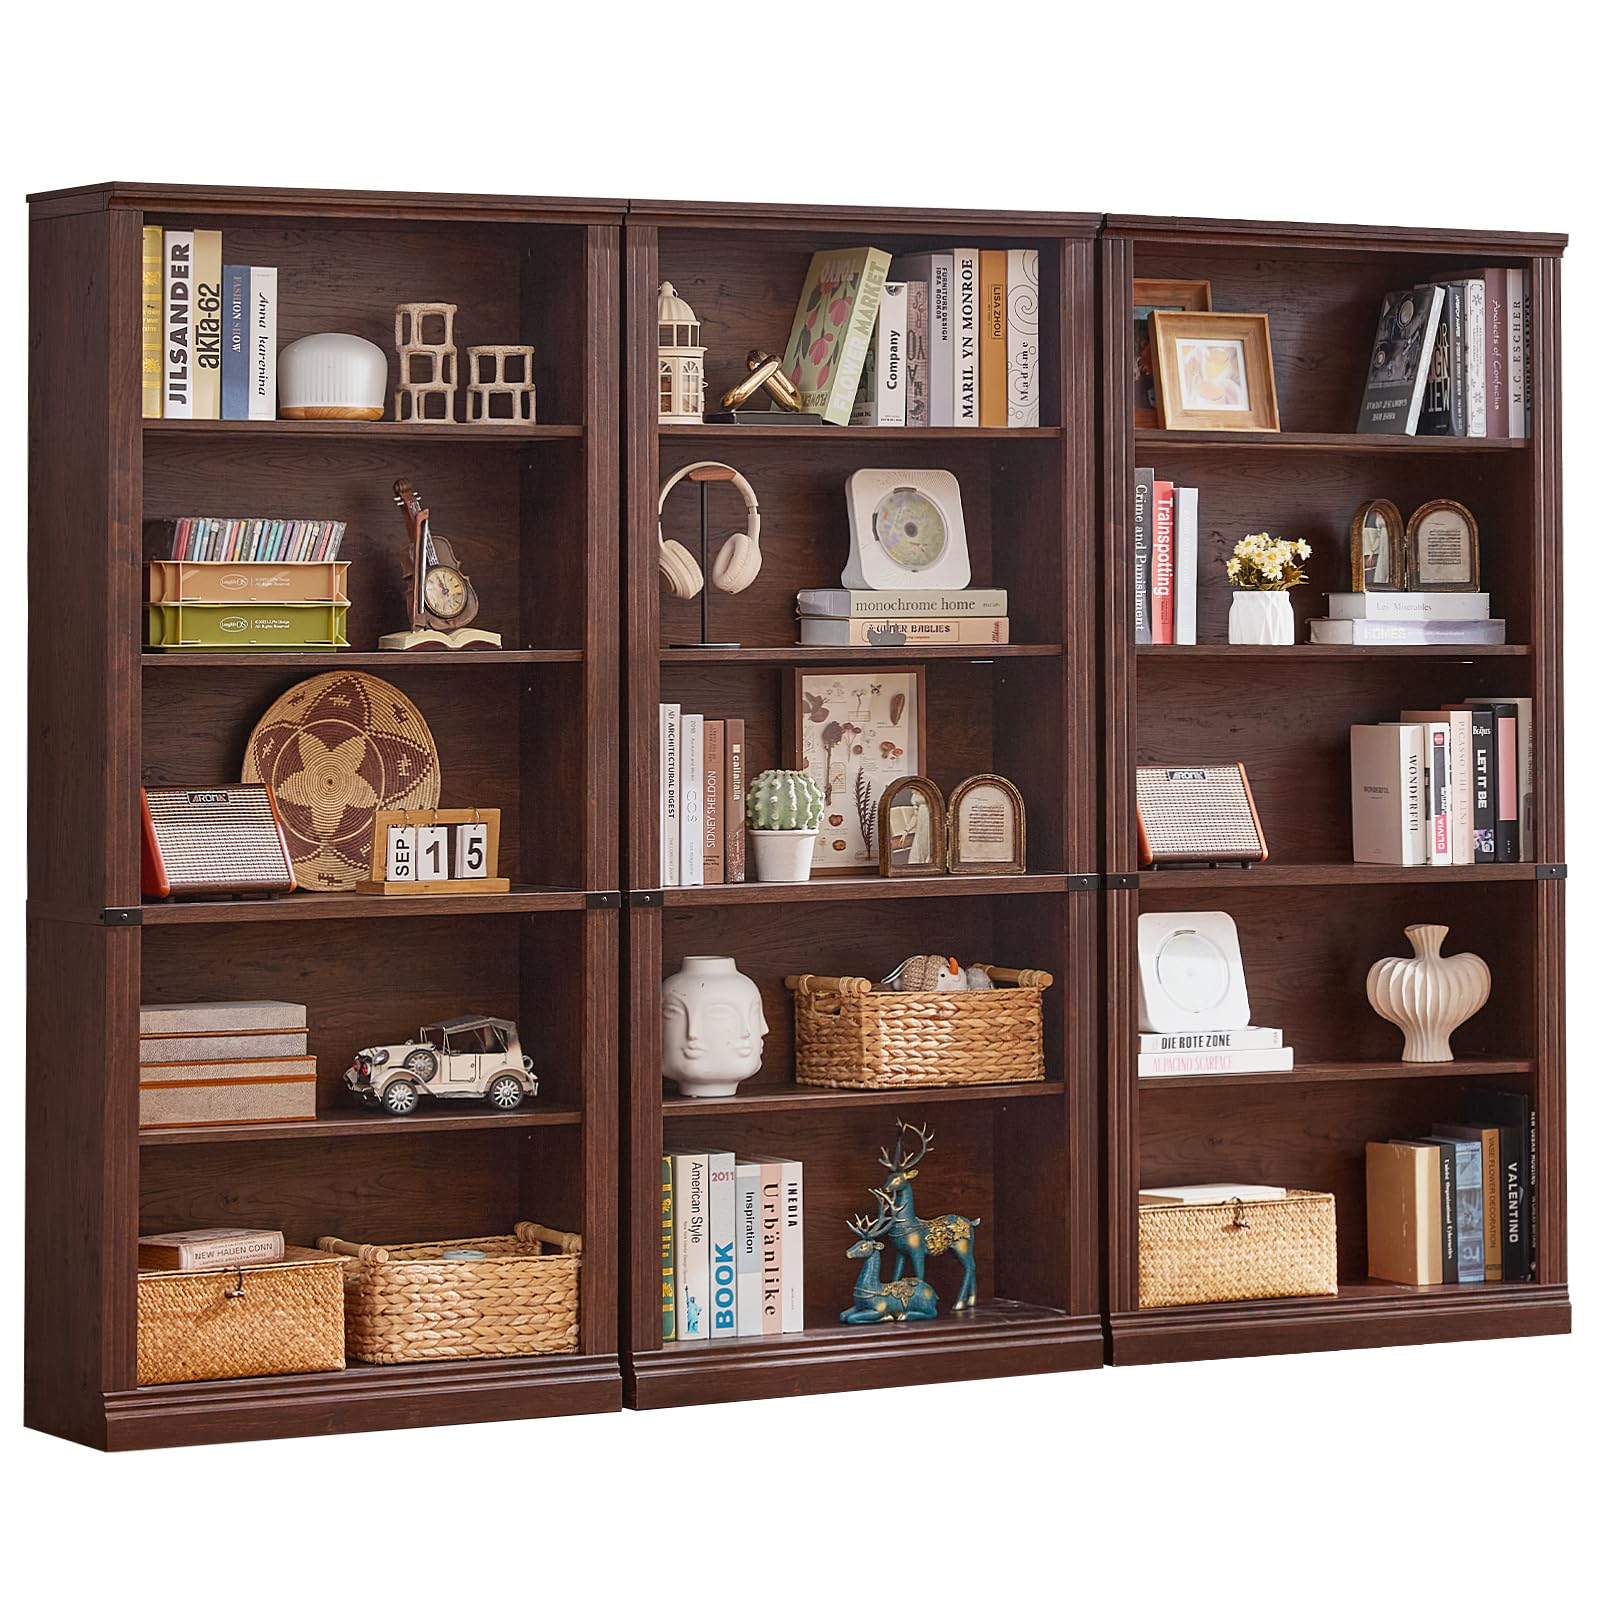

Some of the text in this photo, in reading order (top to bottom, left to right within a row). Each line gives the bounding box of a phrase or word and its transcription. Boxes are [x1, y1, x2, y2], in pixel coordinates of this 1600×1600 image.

[168, 244, 190, 404] JILSANDER
[232, 276, 242, 352] FASHION SHOW
[258, 292, 269, 396] Anna karenina
[834, 336, 867, 412] FLOWER
[853, 260, 885, 336] MARKET
[962, 259, 973, 418] MARIL YN MONROE
[1513, 301, 1521, 362] ESCHER
[886, 330, 900, 390] Company
[1020, 342, 1029, 401] Madame
[1492, 299, 1502, 410] Analects of Confucius
[1135, 484, 1147, 632] Crime and Punishment
[856, 598, 937, 612] monochrome
[941, 598, 976, 610] home
[687, 790, 697, 822] COS
[707, 770, 717, 814] SHELDON
[1409, 754, 1418, 832] WONDERFUL
[1477, 749, 1487, 809] LET IT BE
[396, 838, 483, 876] SEP 1 5
[707, 816, 716, 848] SIDNEY
[1162, 1035, 1231, 1050] DIE ROTE ZONE
[1195, 1055, 1232, 1070] SCARFACE
[688, 1162, 703, 1244] American Style
[712, 1172, 734, 1182] 2011
[788, 1183, 798, 1227] INEDIA
[1508, 1162, 1518, 1243] VALENTINO
[195, 1252, 214, 1260] NEW
[249, 1243, 273, 1253] CONN
[744, 1192, 754, 1254] Inspiration
[763, 1184, 780, 1316] Urbänlike
[715, 1242, 734, 1329] BOOK
